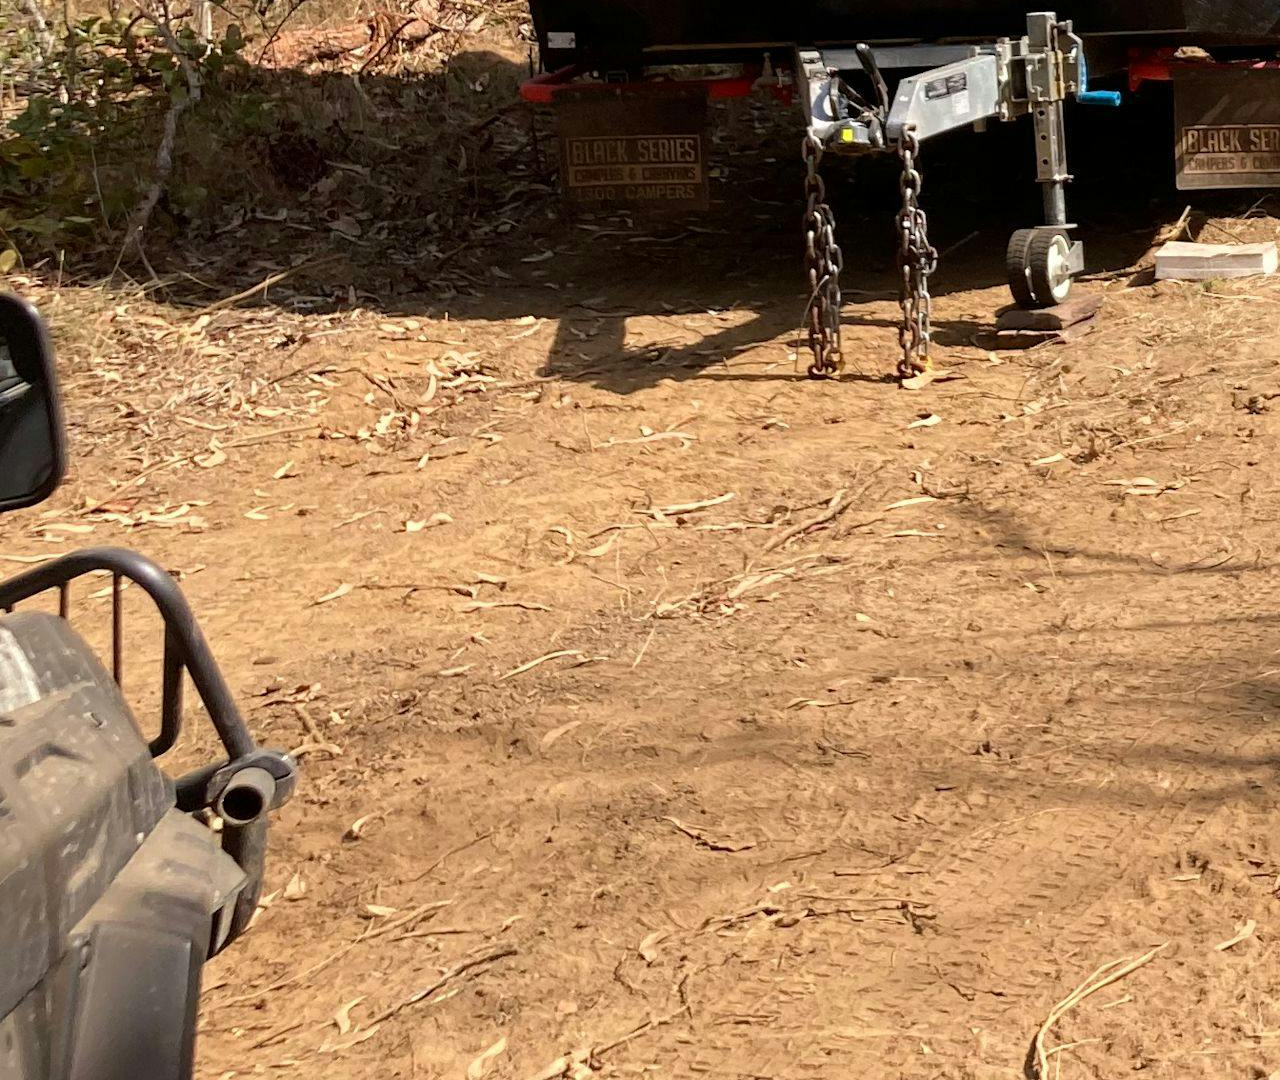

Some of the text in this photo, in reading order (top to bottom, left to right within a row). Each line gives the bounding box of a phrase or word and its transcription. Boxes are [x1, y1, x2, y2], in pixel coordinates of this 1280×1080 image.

[573, 138, 696, 164] BLACK SERIES
[1187, 129, 1242, 153] BLACK
[625, 185, 696, 200] CAMPERS
